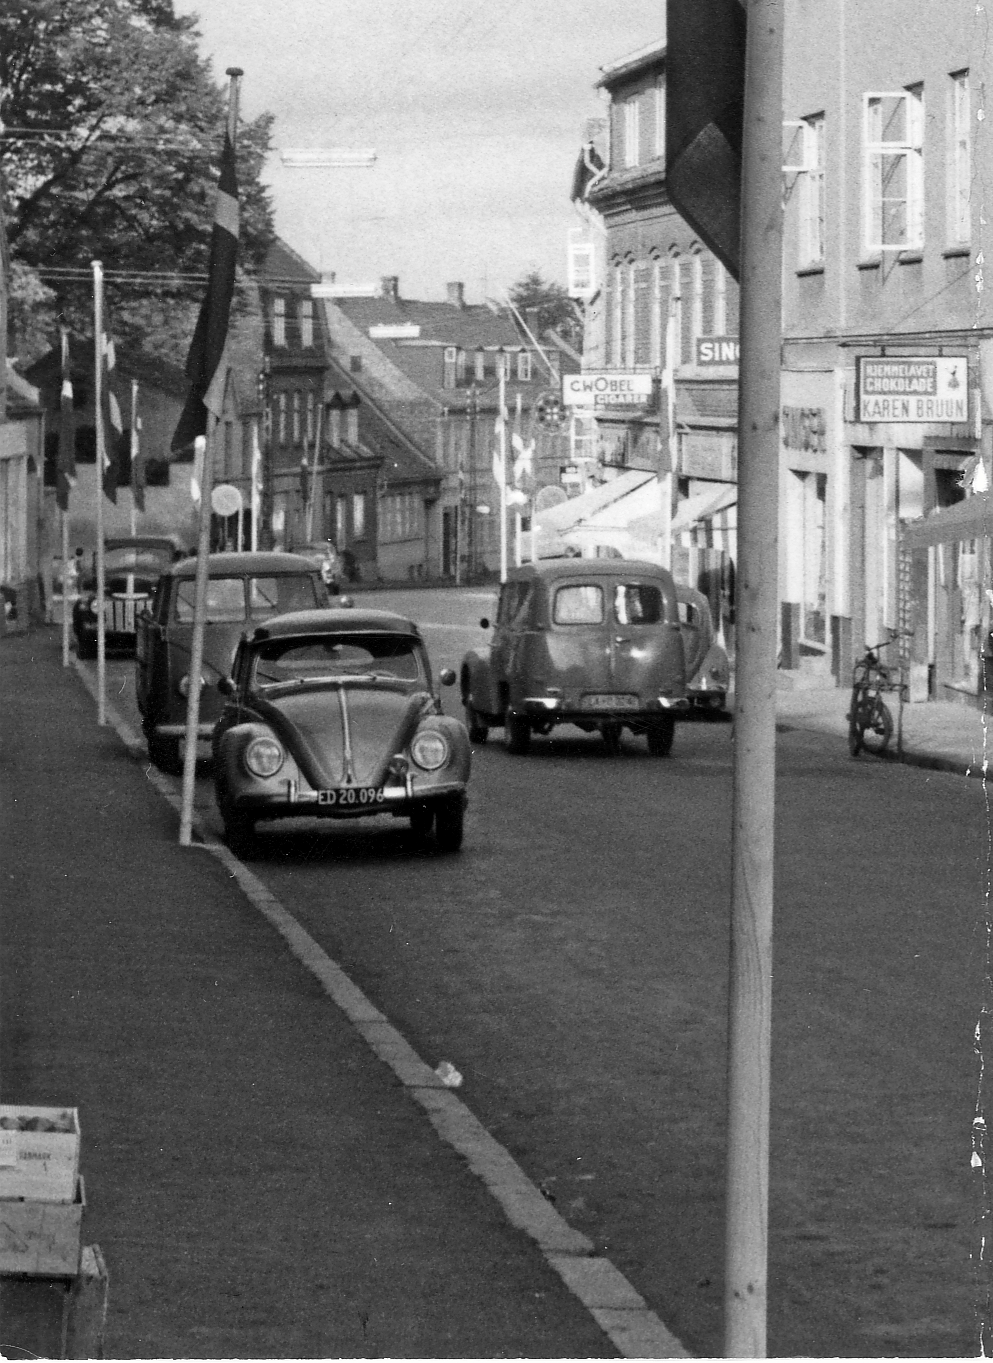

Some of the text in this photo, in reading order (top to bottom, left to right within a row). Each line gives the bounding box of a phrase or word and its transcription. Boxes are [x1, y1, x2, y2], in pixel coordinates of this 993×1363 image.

[700, 342, 741, 361] SIN
[865, 364, 935, 378] HJEMMELAVET
[865, 377, 935, 392] CHOKOLADE
[862, 398, 964, 418] KAREN BRUUN
[318, 788, 385, 805] ED 20.096
